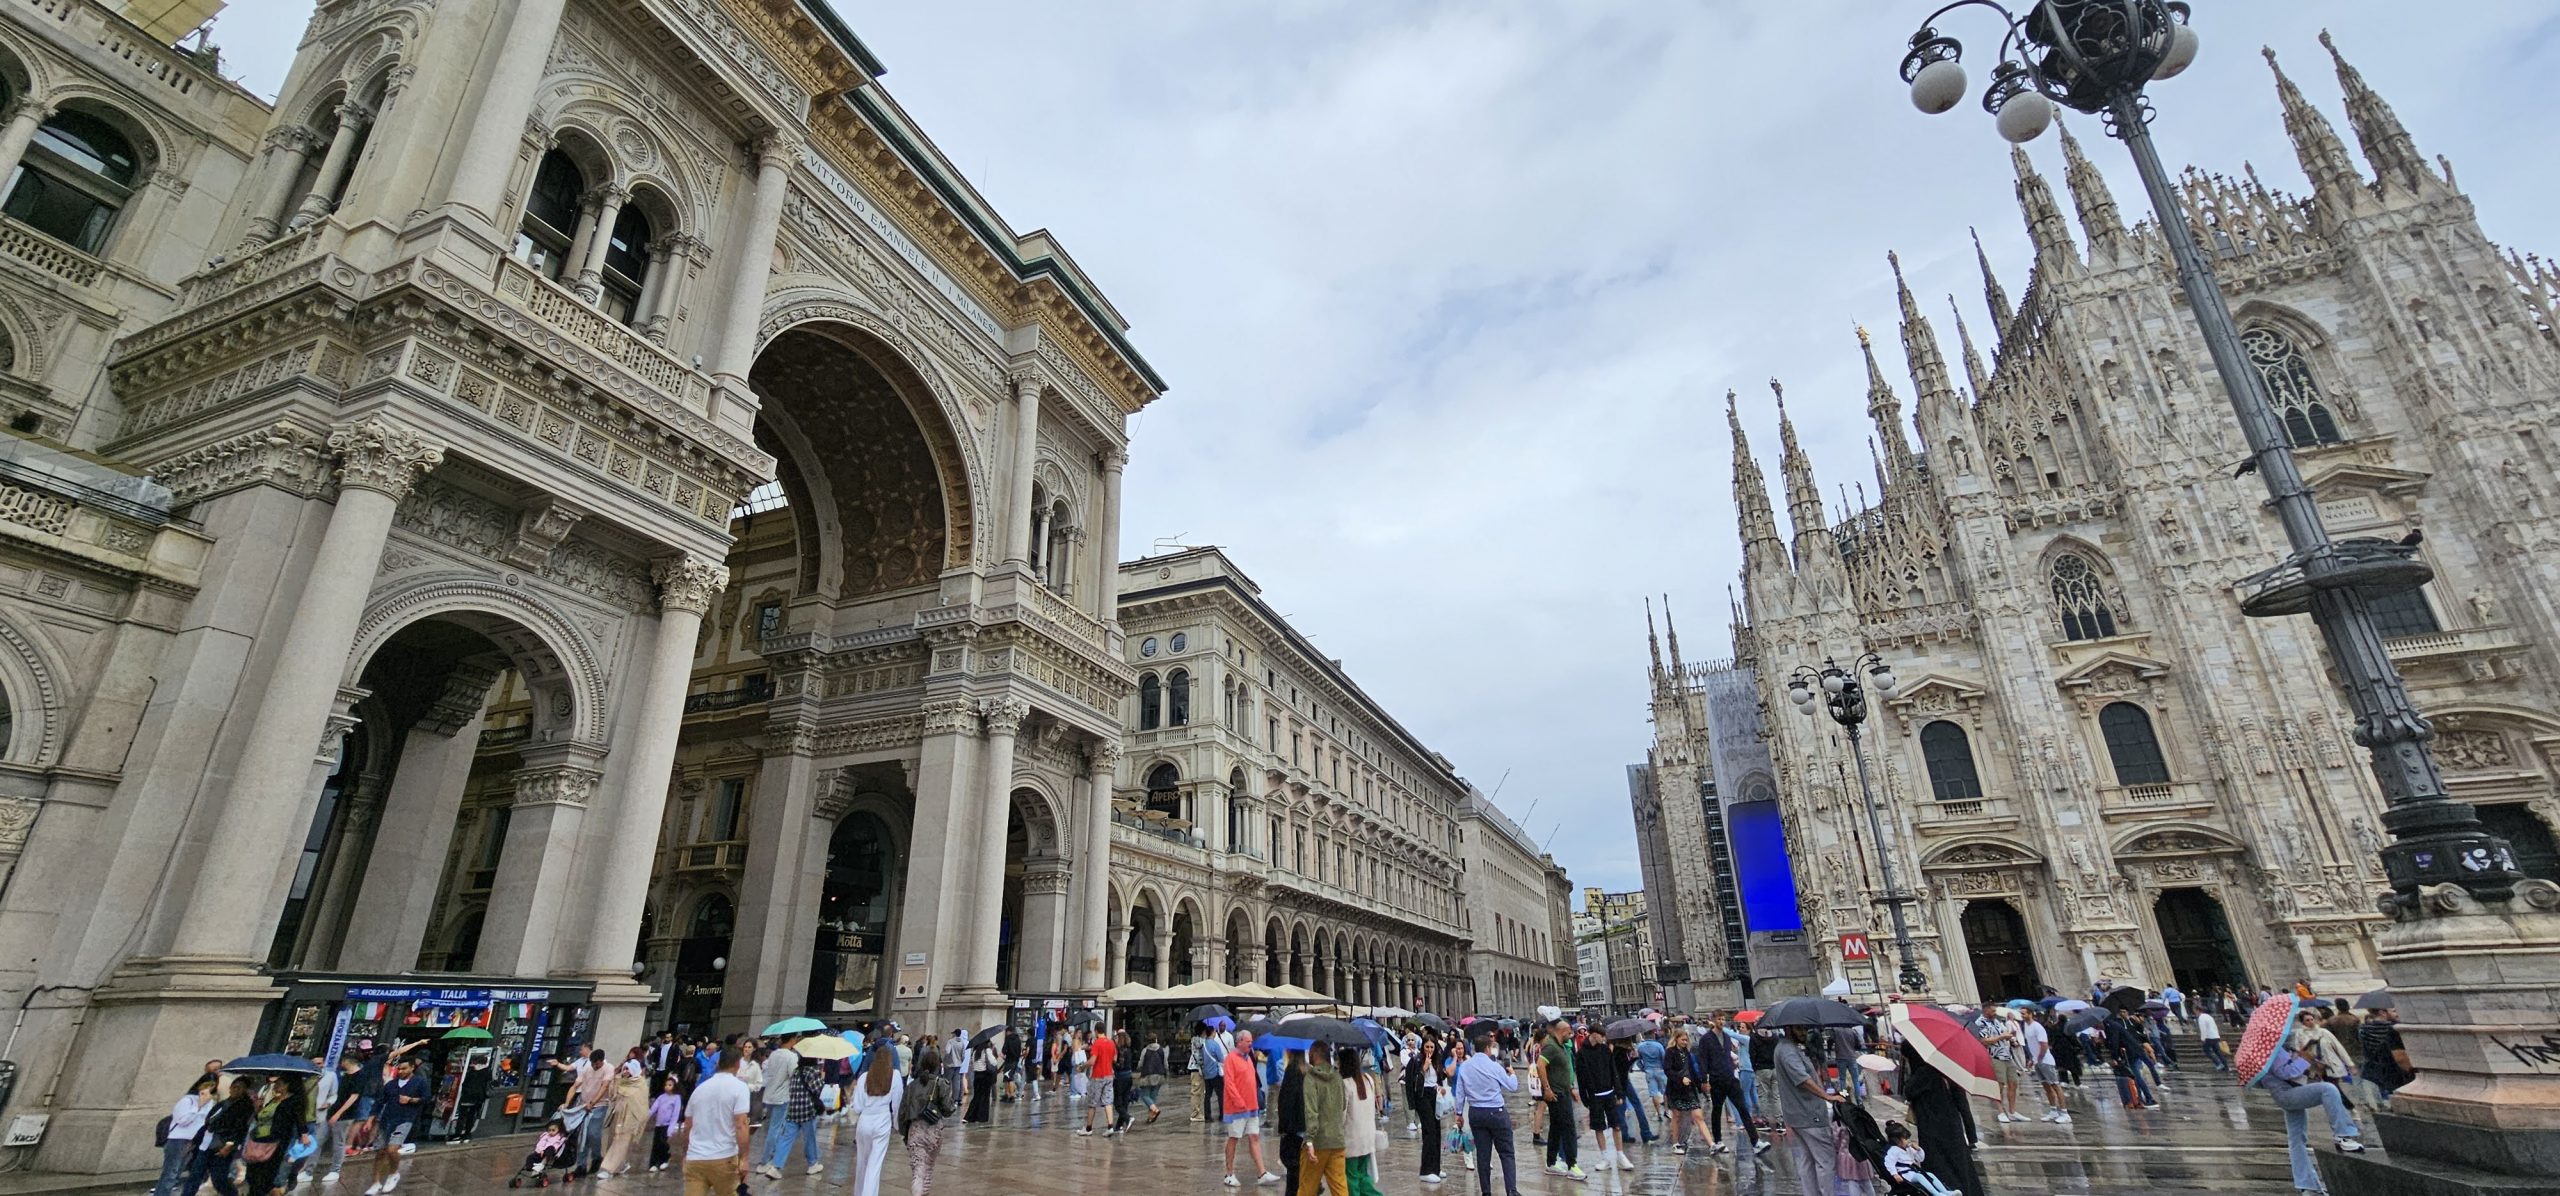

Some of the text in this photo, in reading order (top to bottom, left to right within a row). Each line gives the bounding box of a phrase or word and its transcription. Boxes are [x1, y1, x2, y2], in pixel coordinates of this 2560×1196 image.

[810, 155, 865, 213] VITTORIO
[870, 212, 928, 273] EMANUELE
[956, 293, 997, 336] MILANESI
[837, 934, 862, 948] Motta
[1844, 938, 1868, 955] M
[361, 989, 410, 997] #FORZAAZZURRI
[440, 990, 467, 999] ITALIA
[506, 991, 528, 999] ITALIA
[531, 1026, 545, 1052] ITALIA
